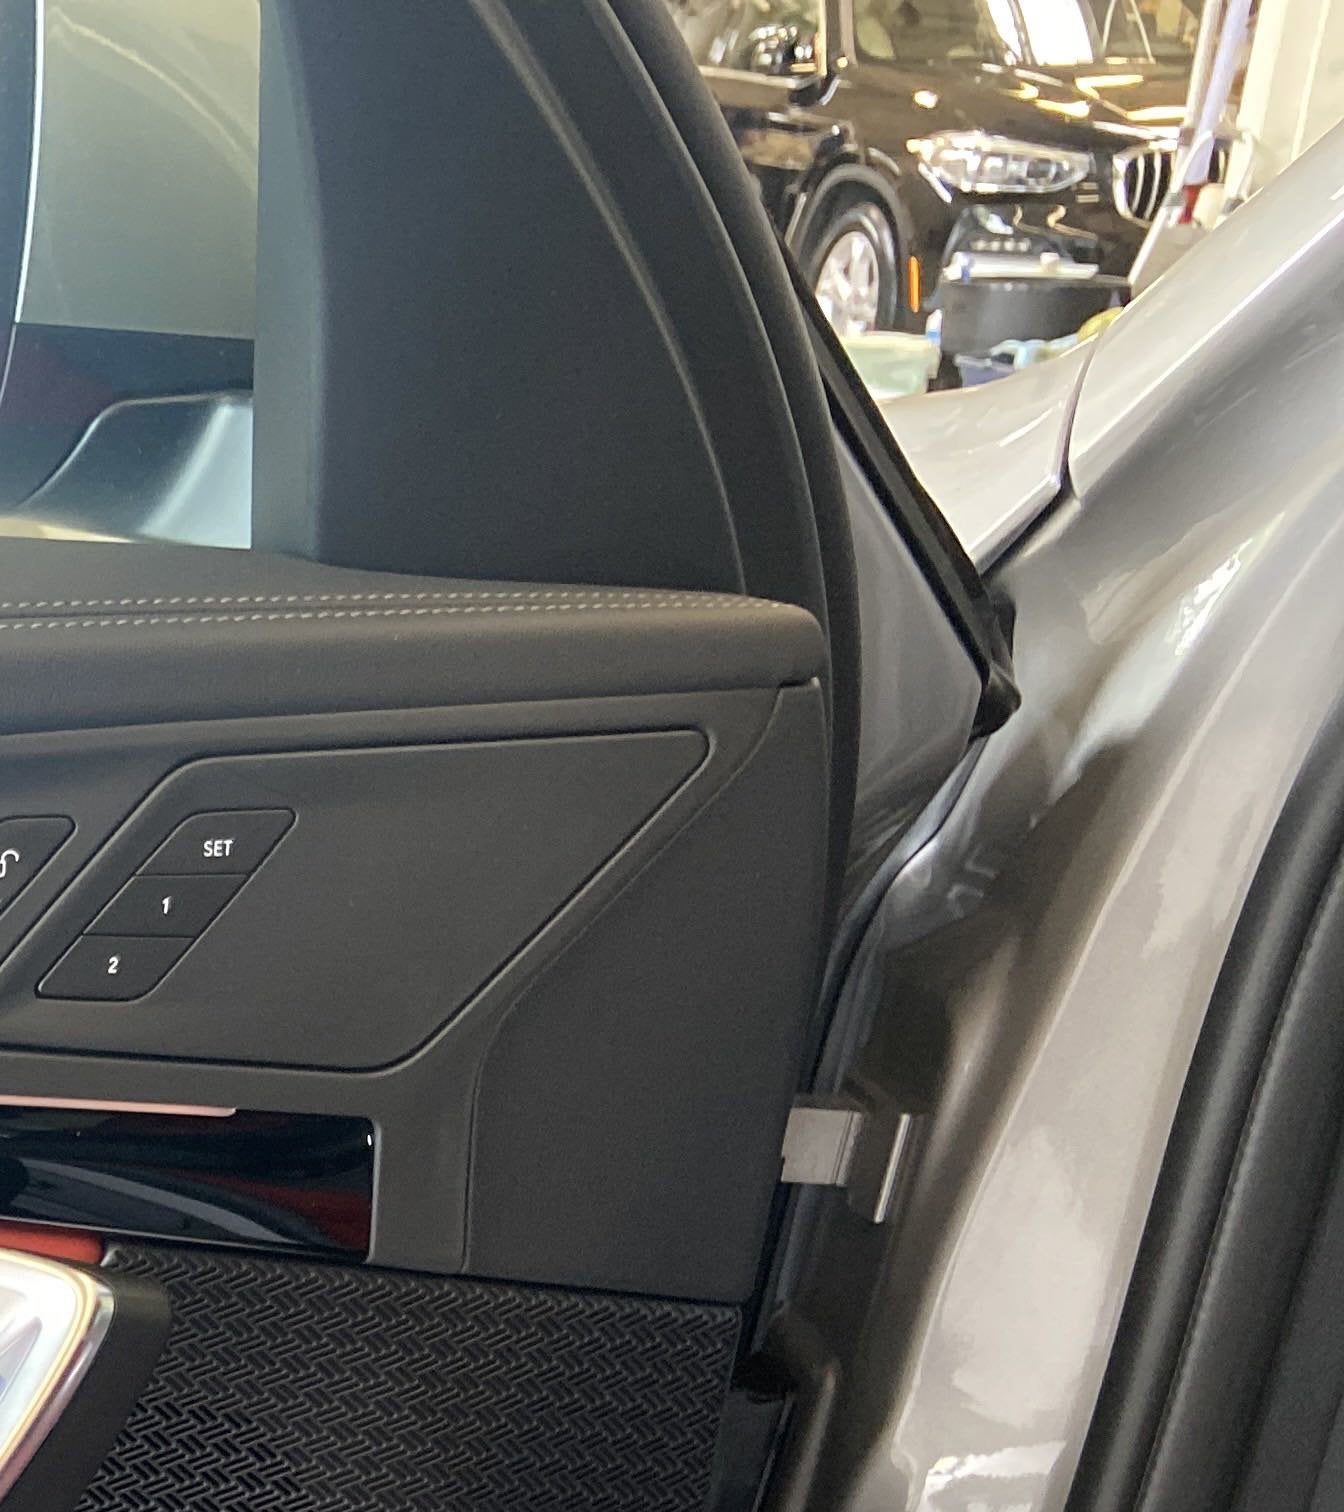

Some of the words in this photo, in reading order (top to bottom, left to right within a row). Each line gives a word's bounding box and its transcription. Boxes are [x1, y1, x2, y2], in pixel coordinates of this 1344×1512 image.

[203, 839, 234, 857] SET
[162, 896, 172, 914] 1
[107, 955, 120, 974] 2
